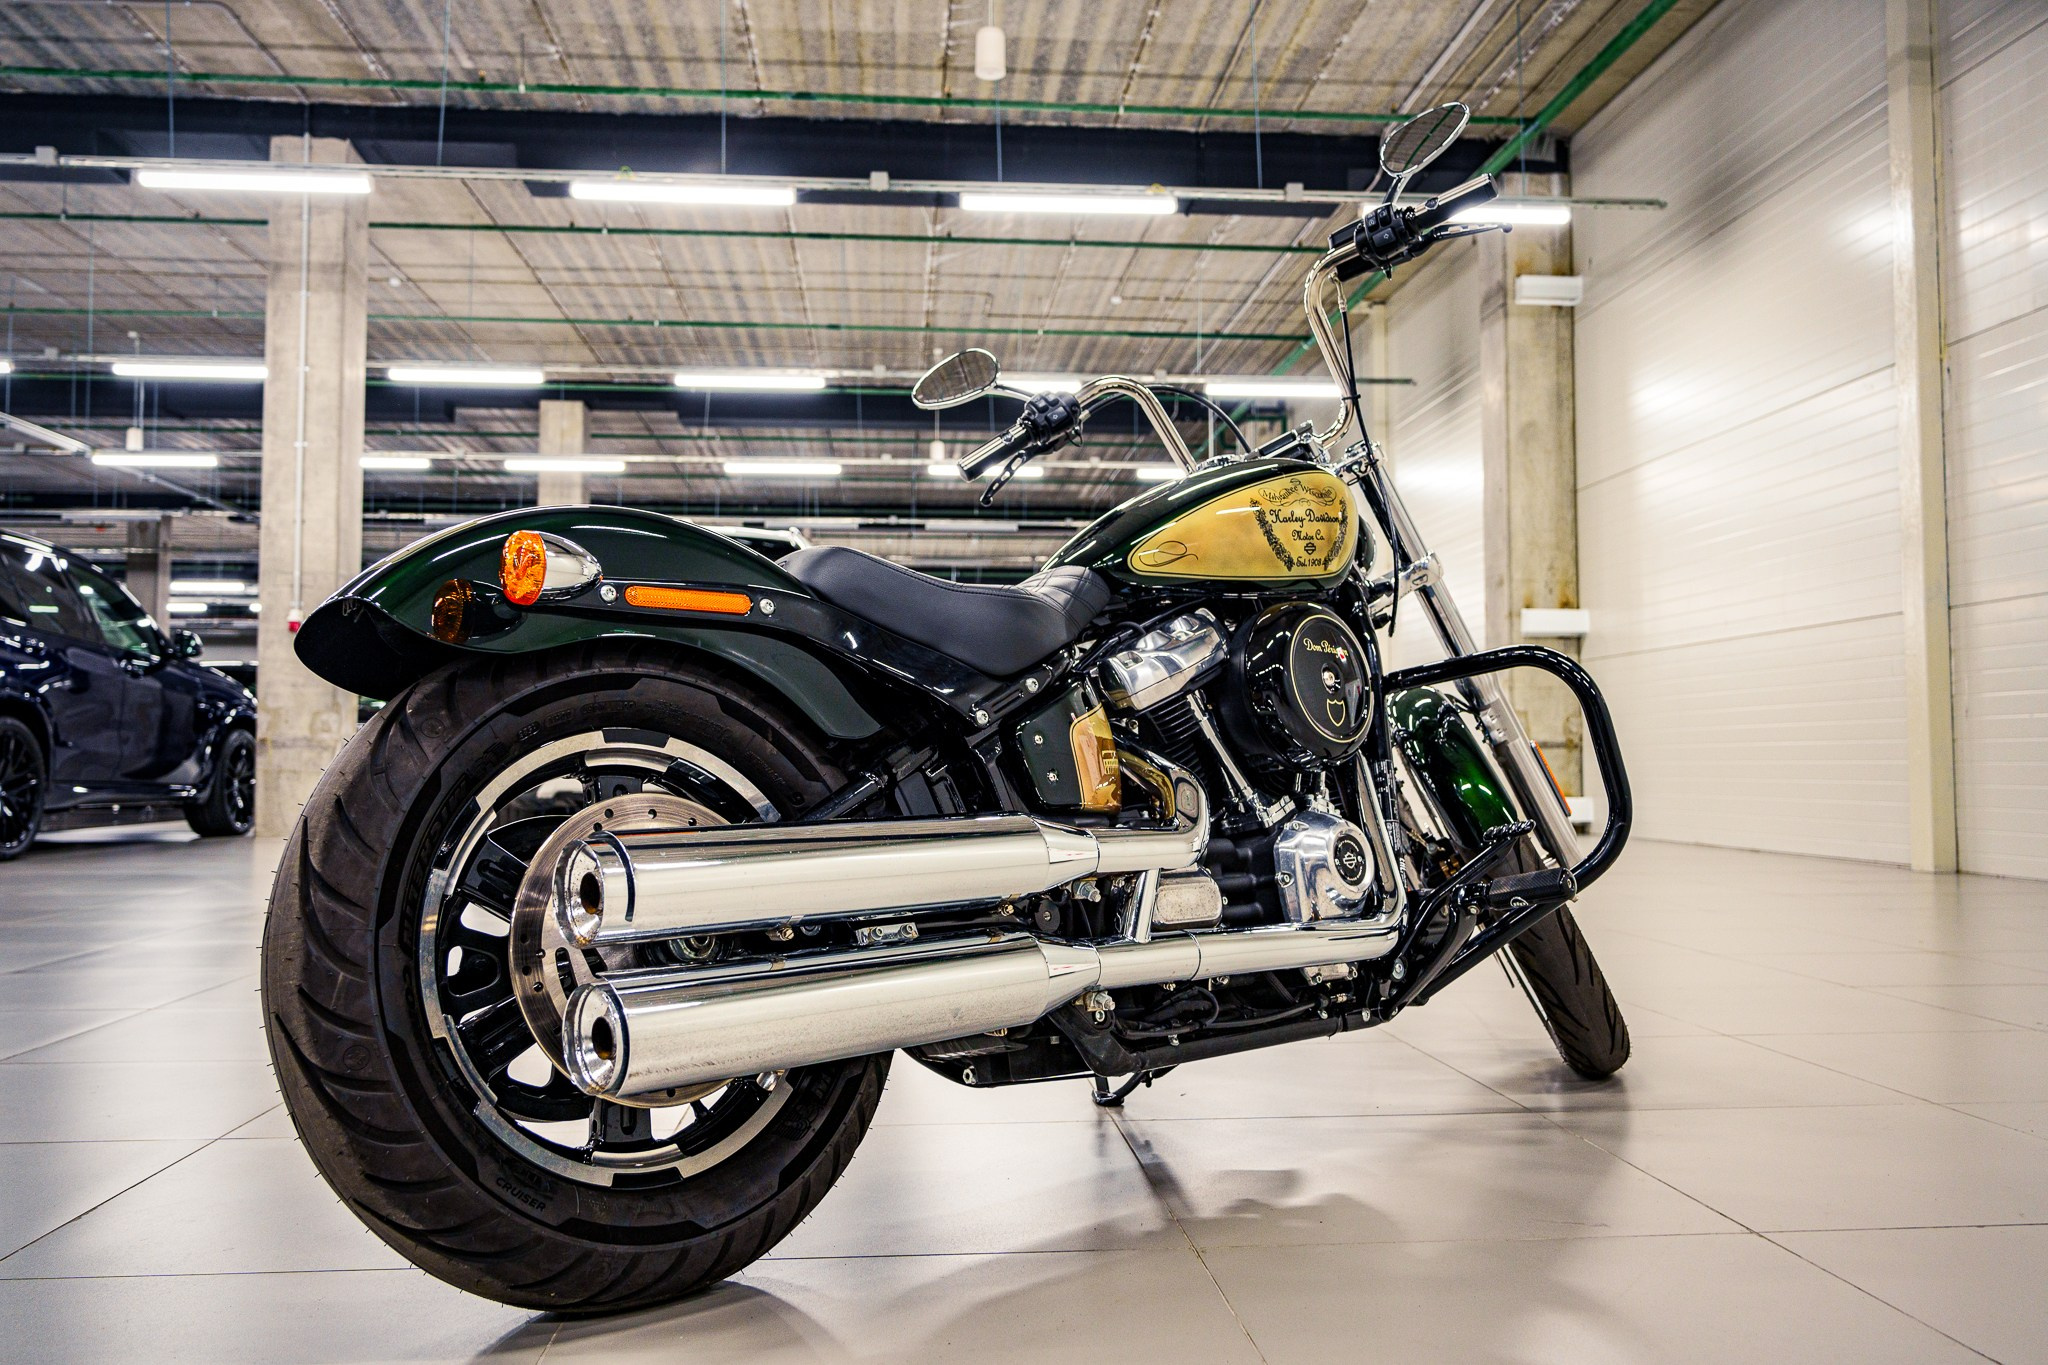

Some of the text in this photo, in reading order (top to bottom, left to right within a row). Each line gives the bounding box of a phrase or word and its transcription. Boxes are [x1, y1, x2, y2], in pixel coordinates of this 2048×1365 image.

[1291, 529, 1314, 541] Motor
[1303, 637, 1322, 652] Dom
[496, 1177, 547, 1212] CRUISER
